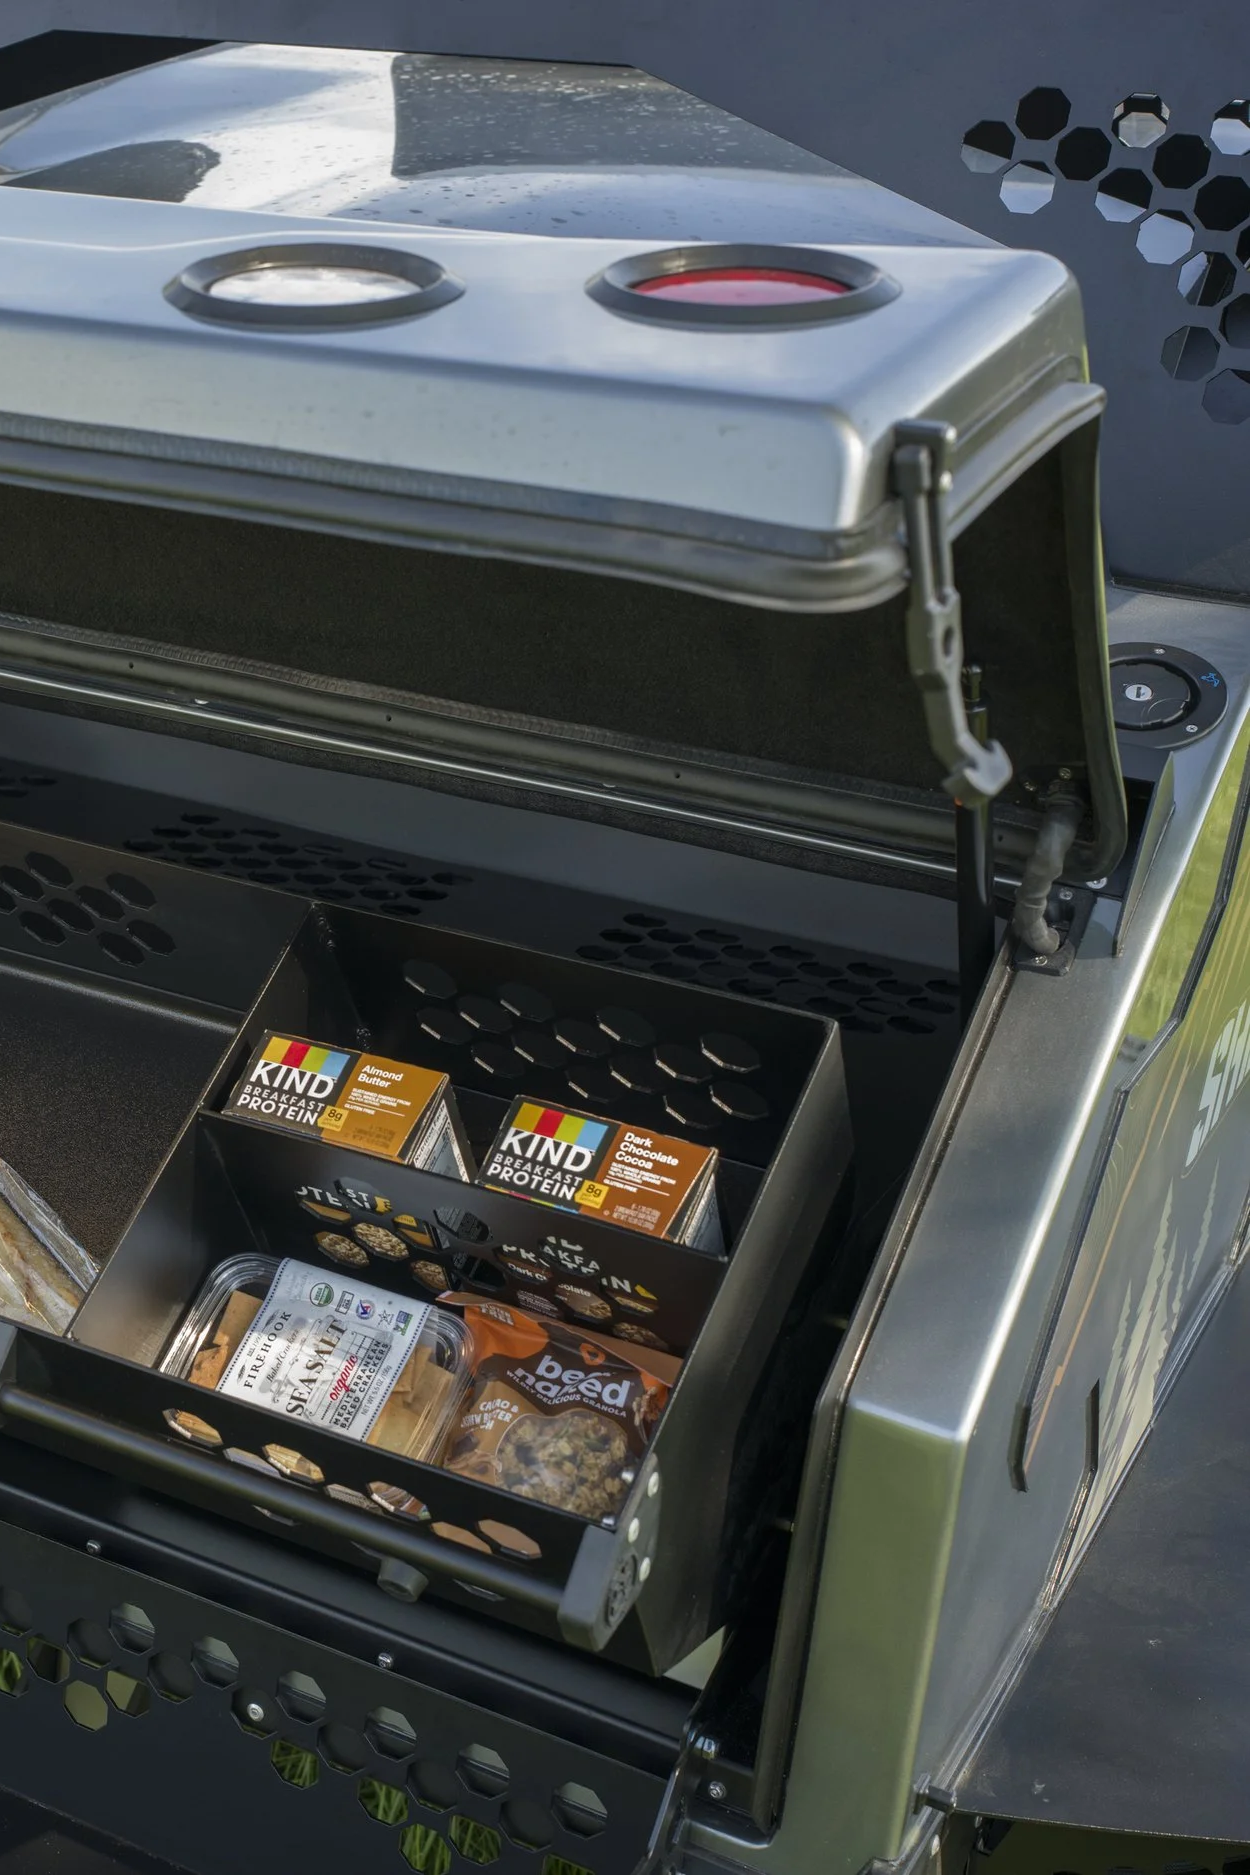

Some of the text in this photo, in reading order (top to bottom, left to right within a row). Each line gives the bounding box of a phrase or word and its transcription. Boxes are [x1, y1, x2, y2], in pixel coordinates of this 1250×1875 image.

[250, 1059, 335, 1099] KIND
[357, 1073, 391, 1088] Butter
[361, 1064, 404, 1082] Almond
[236, 1093, 319, 1126] PROTEIN
[243, 1084, 325, 1112] BREAKFAST
[362, 1107, 376, 1116] FREE
[363, 1093, 380, 1103] WHOLE
[396, 1097, 412, 1107] FROM
[327, 1108, 343, 1122] 8g
[414, 1125, 436, 1164] Nutrition
[433, 1103, 445, 1128] Facts
[499, 1127, 593, 1173] KIND
[624, 1131, 654, 1148] Dark
[493, 1153, 583, 1187] BREAKFAST
[614, 1151, 654, 1170] Cocoa
[619, 1141, 679, 1166] Chocolate
[486, 1163, 576, 1201] PROTEIN
[585, 1184, 603, 1198] 8g
[243, 1311, 293, 1389] FIREHOOK
[266, 1328, 300, 1383] Baked Crackers
[285, 1318, 348, 1417] SEA SALT
[329, 1353, 359, 1401] organic
[333, 1340, 382, 1426] MEDITERRANEAN
[339, 1343, 389, 1430] BAKED CRACKERS
[361, 1403, 370, 1416] NET
[377, 1375, 385, 1386] OZ
[506, 1369, 627, 1418] WILDLY DELICIOUS GRANOLA
[510, 1404, 519, 1413] &
